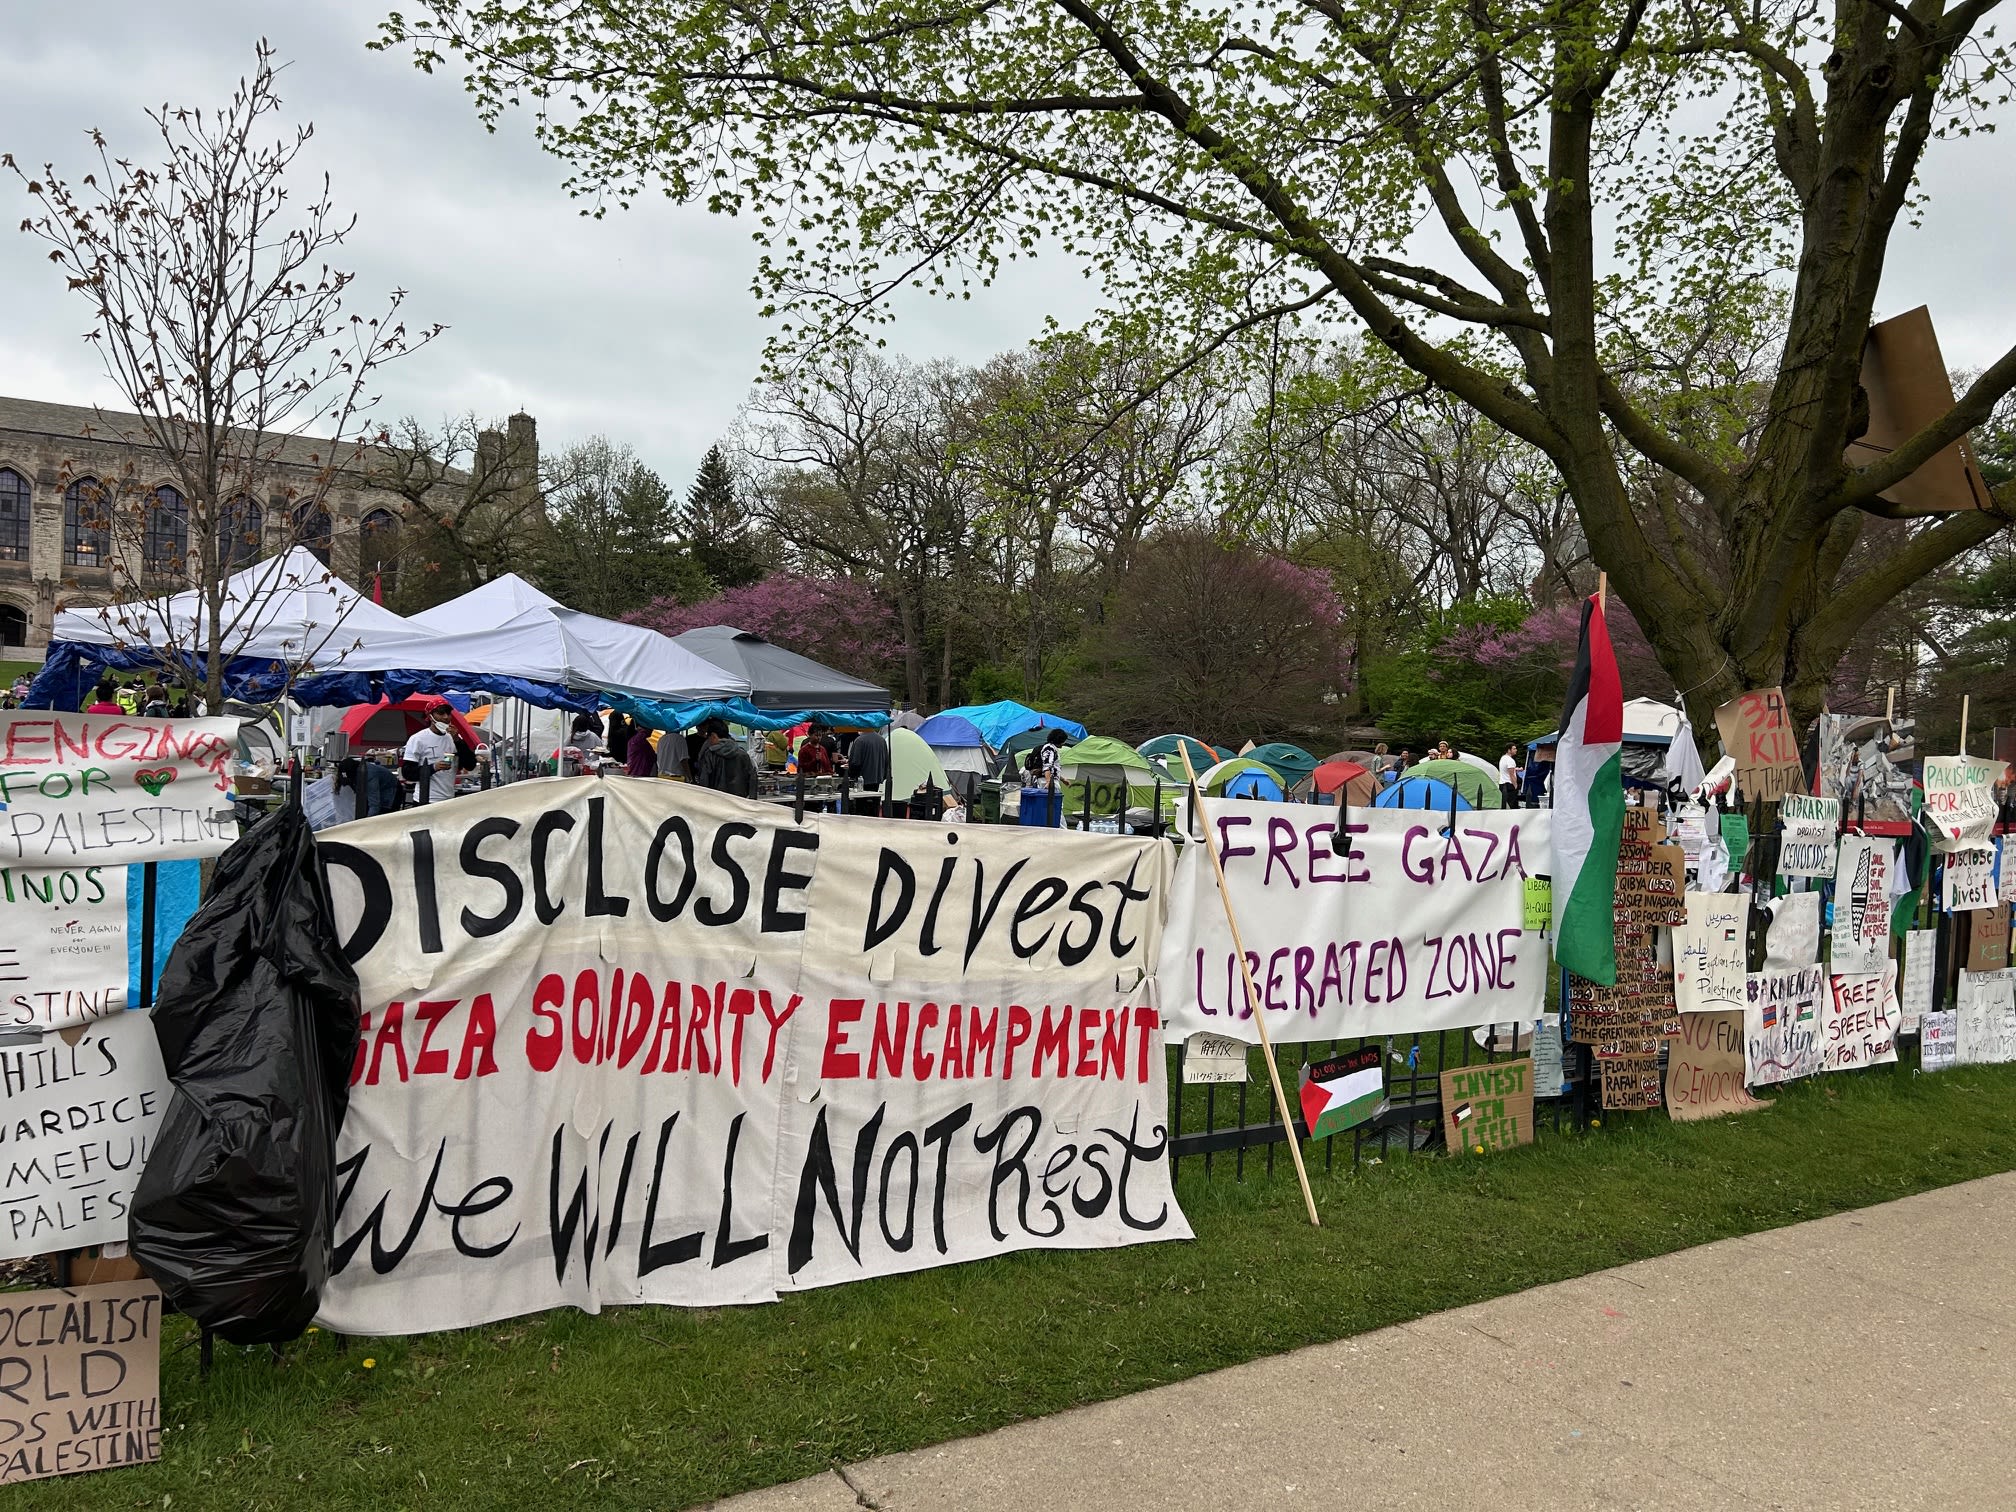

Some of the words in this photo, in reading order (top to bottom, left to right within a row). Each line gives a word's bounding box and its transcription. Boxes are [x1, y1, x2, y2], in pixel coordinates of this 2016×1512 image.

[0, 767, 117, 803] FOR
[1929, 792, 1958, 812] FOR
[11, 806, 234, 858] PALESTINE
[1217, 816, 1370, 888] FREE
[1402, 825, 1528, 884] GAZA
[1783, 843, 1828, 870] GENOCIDE
[316, 797, 819, 965] DISCLOSE
[1646, 861, 1673, 876] DEIR
[1, 866, 105, 904] INOS
[1620, 876, 1647, 891] QIBYA
[1952, 879, 1987, 907] Divest
[1644, 896, 1685, 909] INVASION
[50, 926, 85, 934] NEVER
[89, 925, 121, 934] AGAIN
[1643, 910, 1667, 923] FOCUS
[50, 945, 111, 954] EVERYONE!!!
[1729, 948, 1744, 972] for
[1197, 936, 1407, 1019] LIBERATED
[1425, 929, 1522, 999] ZONE
[1761, 969, 1822, 1001] ARMENIA
[1596, 988, 1611, 1003] THE
[1696, 977, 1742, 1000] Palestine
[1829, 974, 1880, 1014] FREE
[1580, 1027, 1597, 1039] THE
[1598, 1026, 1624, 1041] GREAT
[1828, 1002, 1891, 1041] SPEECH
[821, 999, 1158, 1083] ENCAMPMENT
[1620, 1040, 1641, 1053] JENIN
[1, 1037, 117, 1098] HILL'S
[1604, 1059, 1634, 1075] FLOUR
[1837, 1043, 1857, 1066] FOR
[1452, 1064, 1526, 1100] INVEST
[1605, 1074, 1637, 1091] RAFAH
[1475, 1099, 1504, 1125] IN
[1605, 1091, 1646, 1108] AL-SHIFA
[332, 1135, 521, 1276] We
[549, 1110, 770, 1288] WILL
[788, 1101, 973, 1275] NOT
[9, 1190, 136, 1240] PALES
[67, 1397, 156, 1435] WITH
